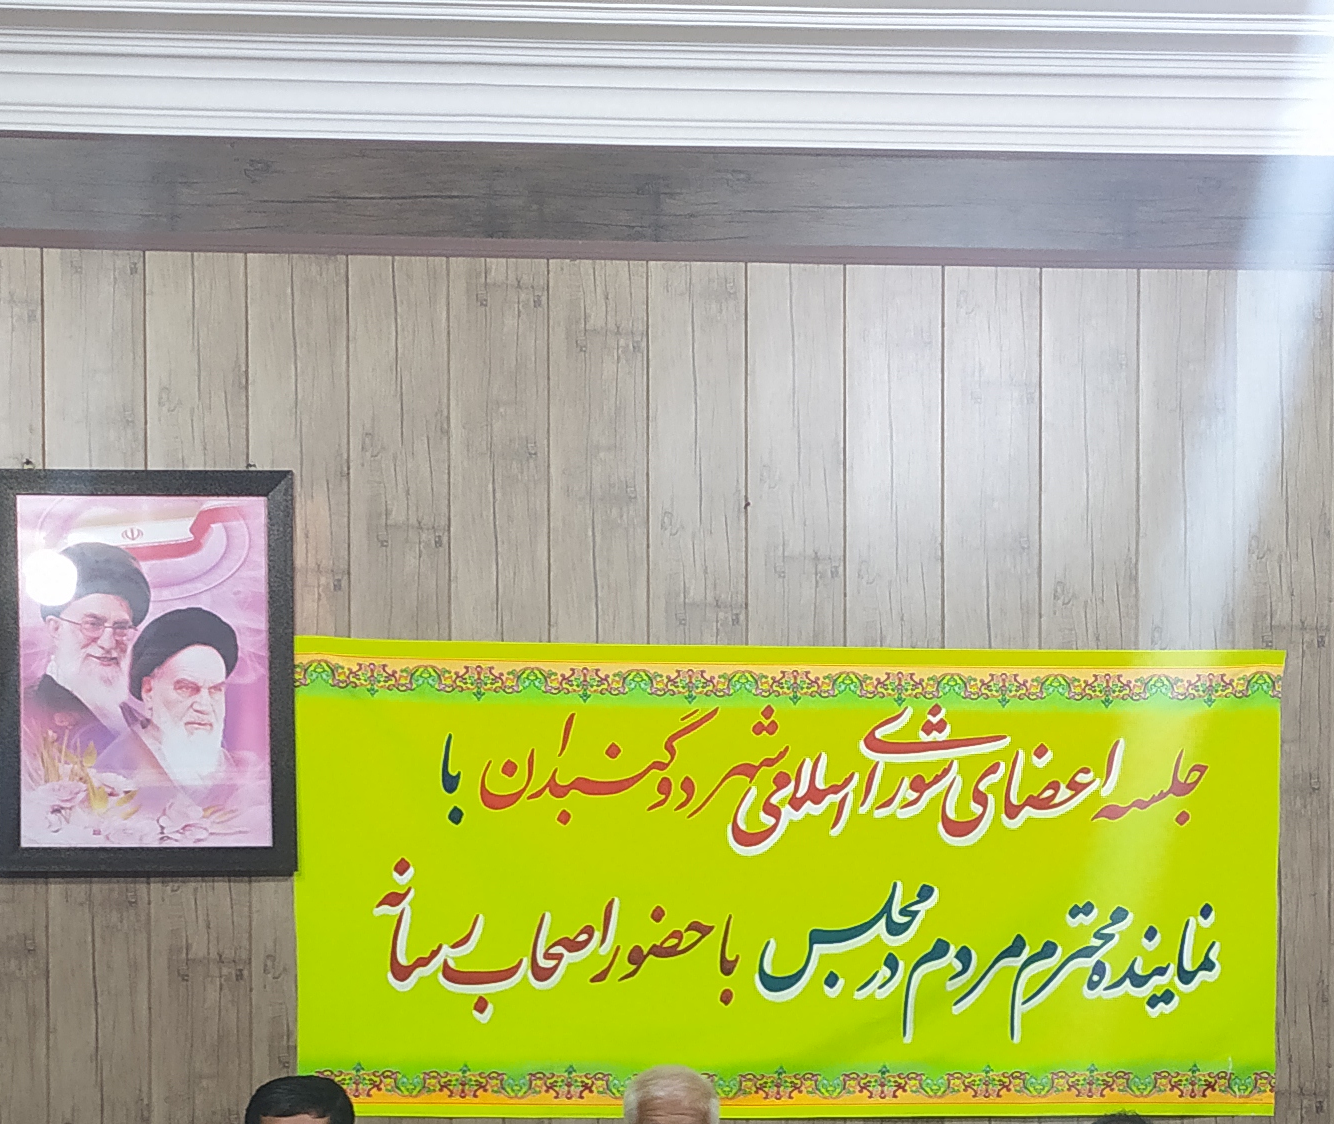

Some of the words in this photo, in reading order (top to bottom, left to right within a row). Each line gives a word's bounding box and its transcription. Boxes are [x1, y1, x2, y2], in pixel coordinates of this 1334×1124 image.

[441, 732, 464, 825] با
[686, 704, 790, 819] شهر
[727, 751, 859, 856] اسلامی
[859, 703, 1011, 819] شورای
[938, 738, 1124, 846] اعضای
[1091, 748, 1209, 826] جلسه
[373, 857, 484, 992] رسانه
[438, 897, 619, 1024] اصحاب
[589, 905, 715, 983] حضور
[719, 913, 740, 1006] با
[754, 880, 939, 1002] مجلس
[853, 952, 904, 1000] در
[1009, 901, 1133, 1044] محترم
[1083, 902, 1221, 1018] نماینده
[903, 934, 1029, 1044] مردم
